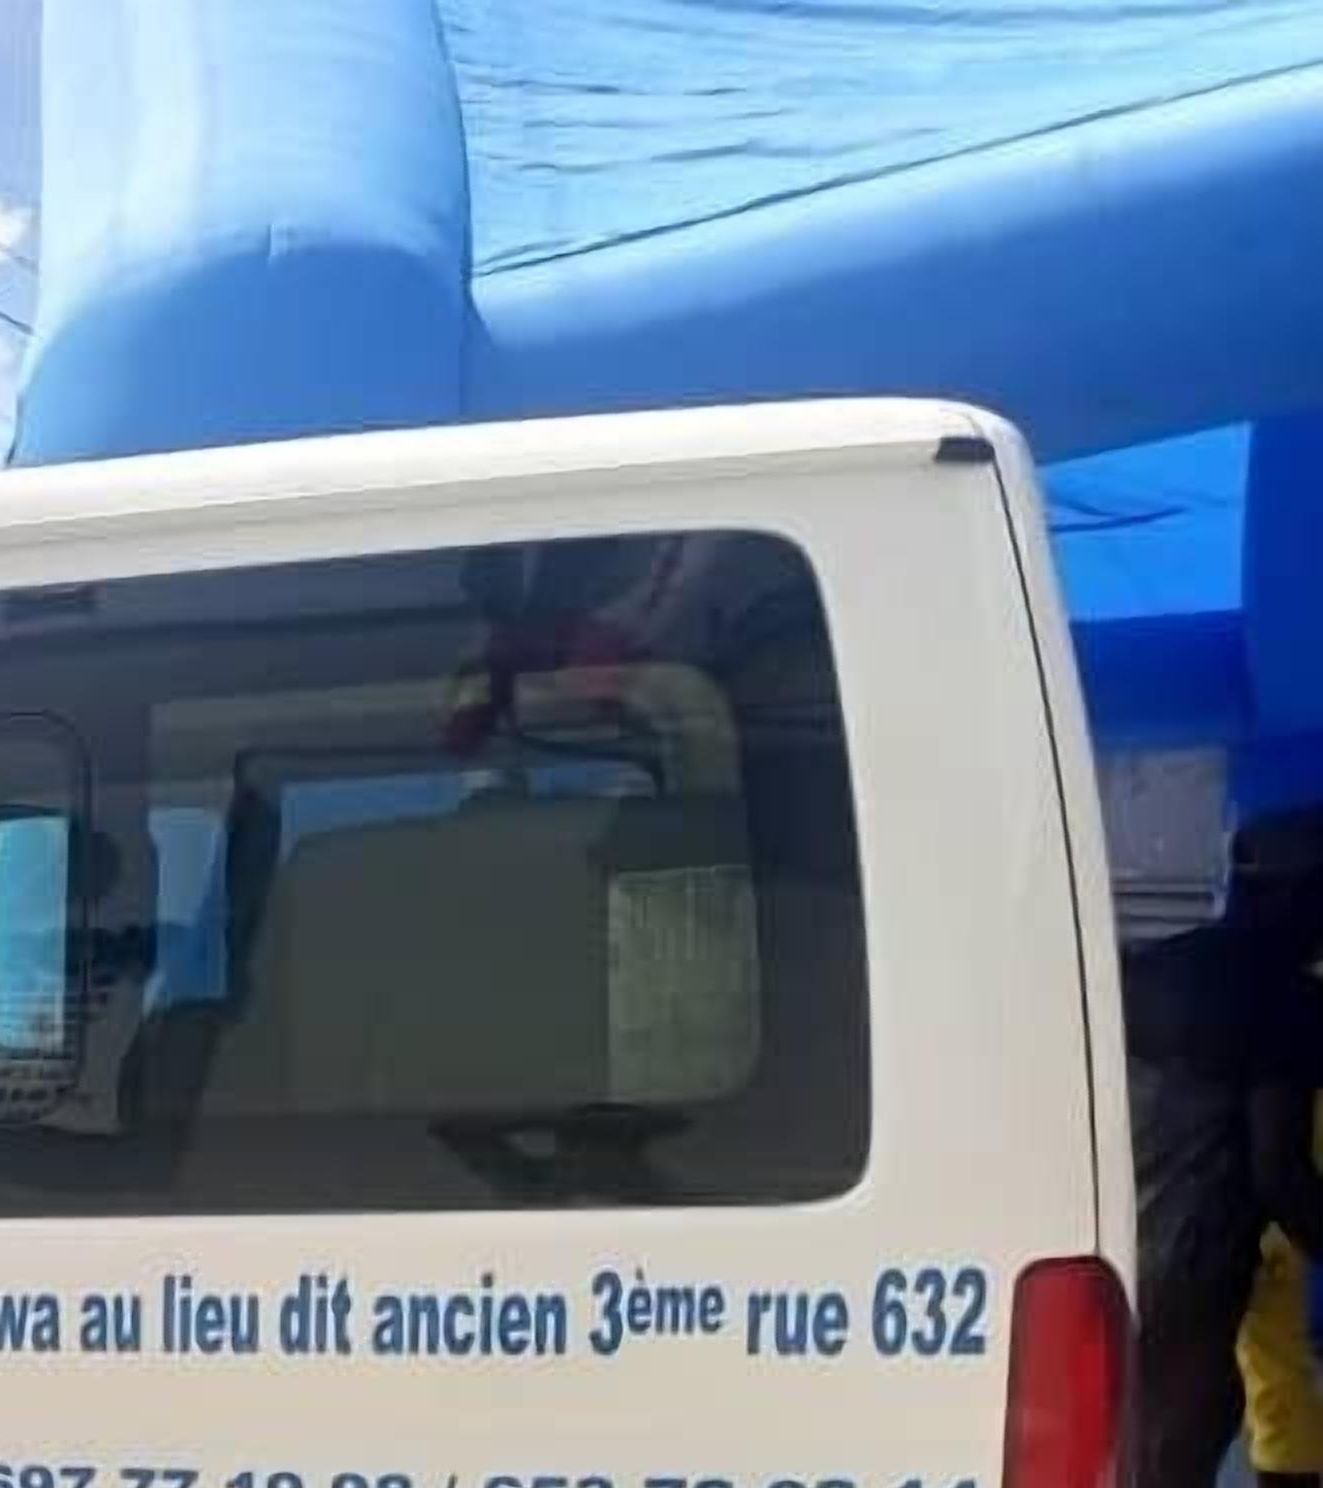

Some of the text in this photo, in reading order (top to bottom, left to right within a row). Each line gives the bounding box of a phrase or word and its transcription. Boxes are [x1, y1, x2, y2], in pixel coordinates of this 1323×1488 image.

[80, 1294, 142, 1353] au
[163, 1274, 260, 1355] lieu
[280, 1273, 352, 1356] dit
[371, 1272, 568, 1357] ancien
[588, 1268, 726, 1357] 3ème
[746, 1292, 850, 1357] rue
[871, 1266, 987, 1357] 632
